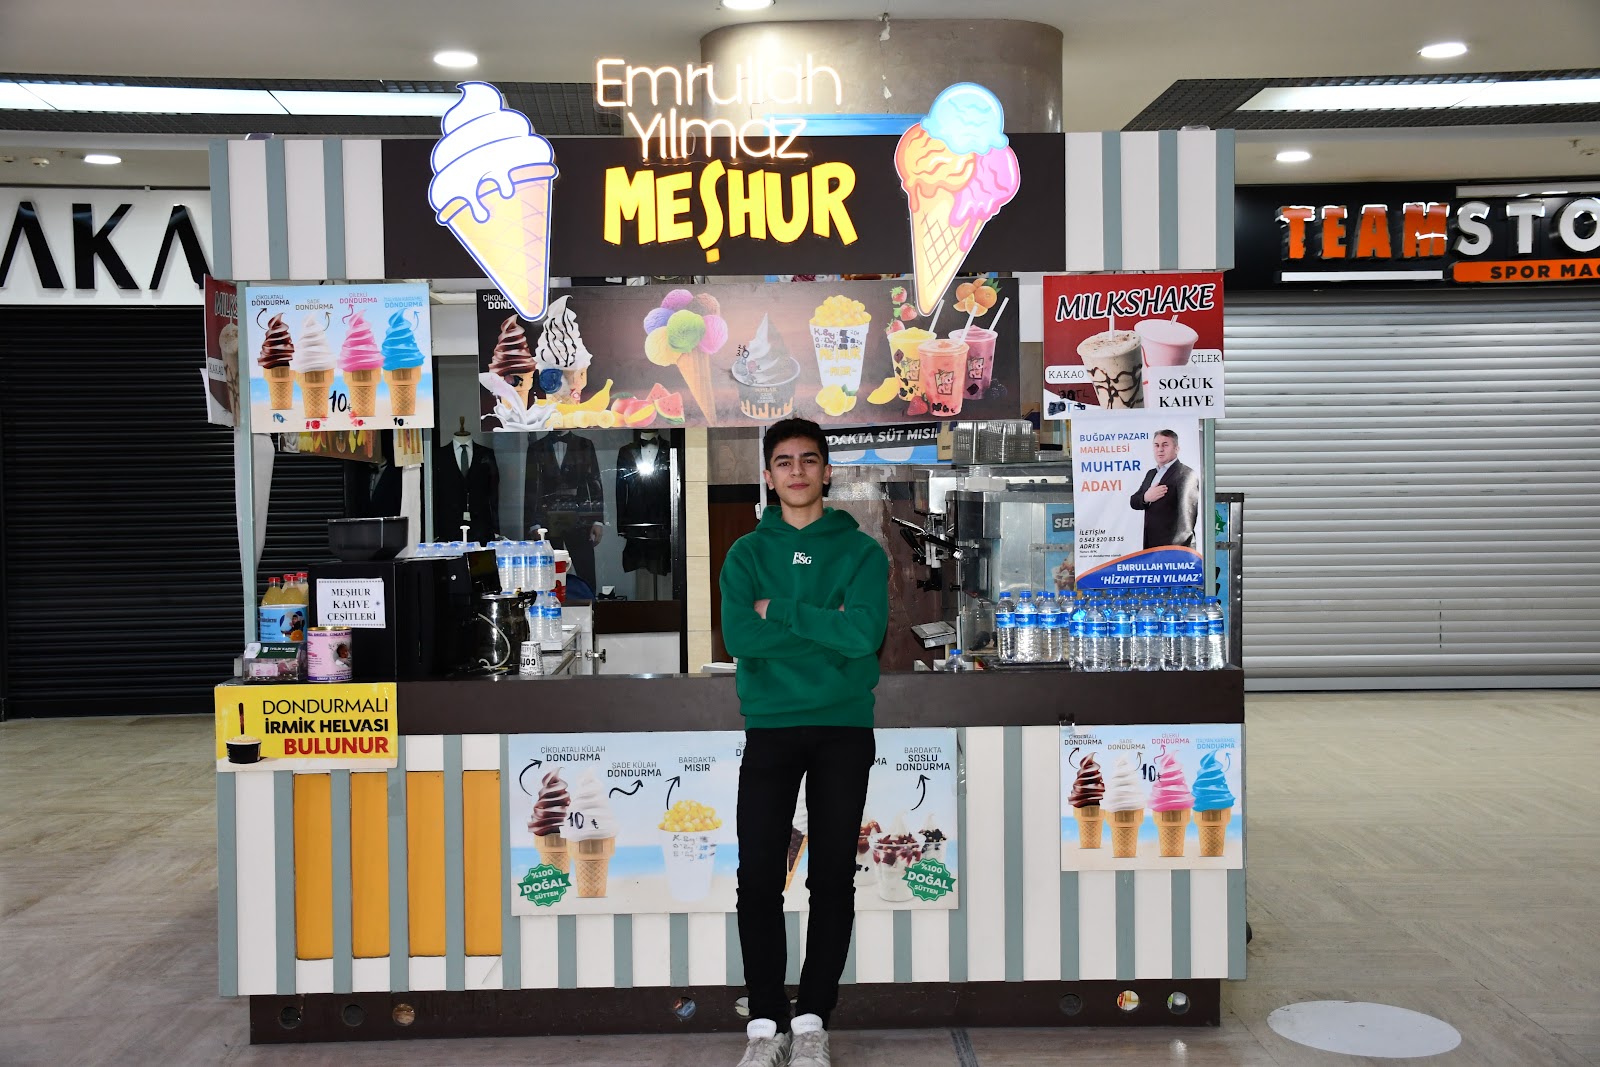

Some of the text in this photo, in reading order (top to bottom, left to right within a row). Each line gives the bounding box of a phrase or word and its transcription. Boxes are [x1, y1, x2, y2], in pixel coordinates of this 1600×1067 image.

[596, 54, 842, 107] Emrullah
[603, 159, 859, 263] MEŞHUR
[1490, 265, 1551, 280] SPOR
[251, 299, 290, 307] DONDURMA
[1055, 283, 1216, 323] MILKSHAKE
[1190, 353, 1221, 365] ÇİLEK
[1047, 370, 1085, 380] KAKAO
[1158, 374, 1214, 391] SOĞUK
[1158, 394, 1215, 409] KAHVE
[876, 427, 905, 443] SÜT
[1079, 431, 1150, 443] BUĞDAY PAZARI
[1079, 443, 1131, 454] MAHALLESİ
[1081, 459, 1142, 473] MUHTAR
[1080, 479, 1123, 493] ADAYI
[1116, 561, 1196, 572] EMRULLAH YILMAZ
[331, 588, 371, 597] MEŞHUR
[333, 600, 370, 609] KAHVE
[327, 610, 376, 622] ÇEŞİTLERİ
[262, 697, 388, 715] DONDURMALI
[264, 716, 389, 734] İRMİK HELVASI
[284, 736, 389, 755] BULUNUR
[540, 744, 606, 754] ÇİKOLATALI KÜLAH
[904, 746, 942, 754] BARDAKTA
[1196, 742, 1235, 750] DONDURMA
[546, 753, 601, 762] DONDURMA
[678, 756, 717, 764] BARDAKTA
[907, 753, 938, 762] SOSLU
[611, 760, 657, 769] SADE KÜLAH
[684, 763, 711, 772] MISIR
[896, 762, 951, 771] DONDURMA
[607, 768, 662, 778] DONDURMA
[531, 868, 554, 879] %100
[920, 862, 943, 874] %100
[907, 871, 949, 890] DOĞAL
[523, 878, 567, 895] DOĞAL
[914, 884, 939, 895] SÜTTEN
[534, 890, 560, 900] SÜTTEN
